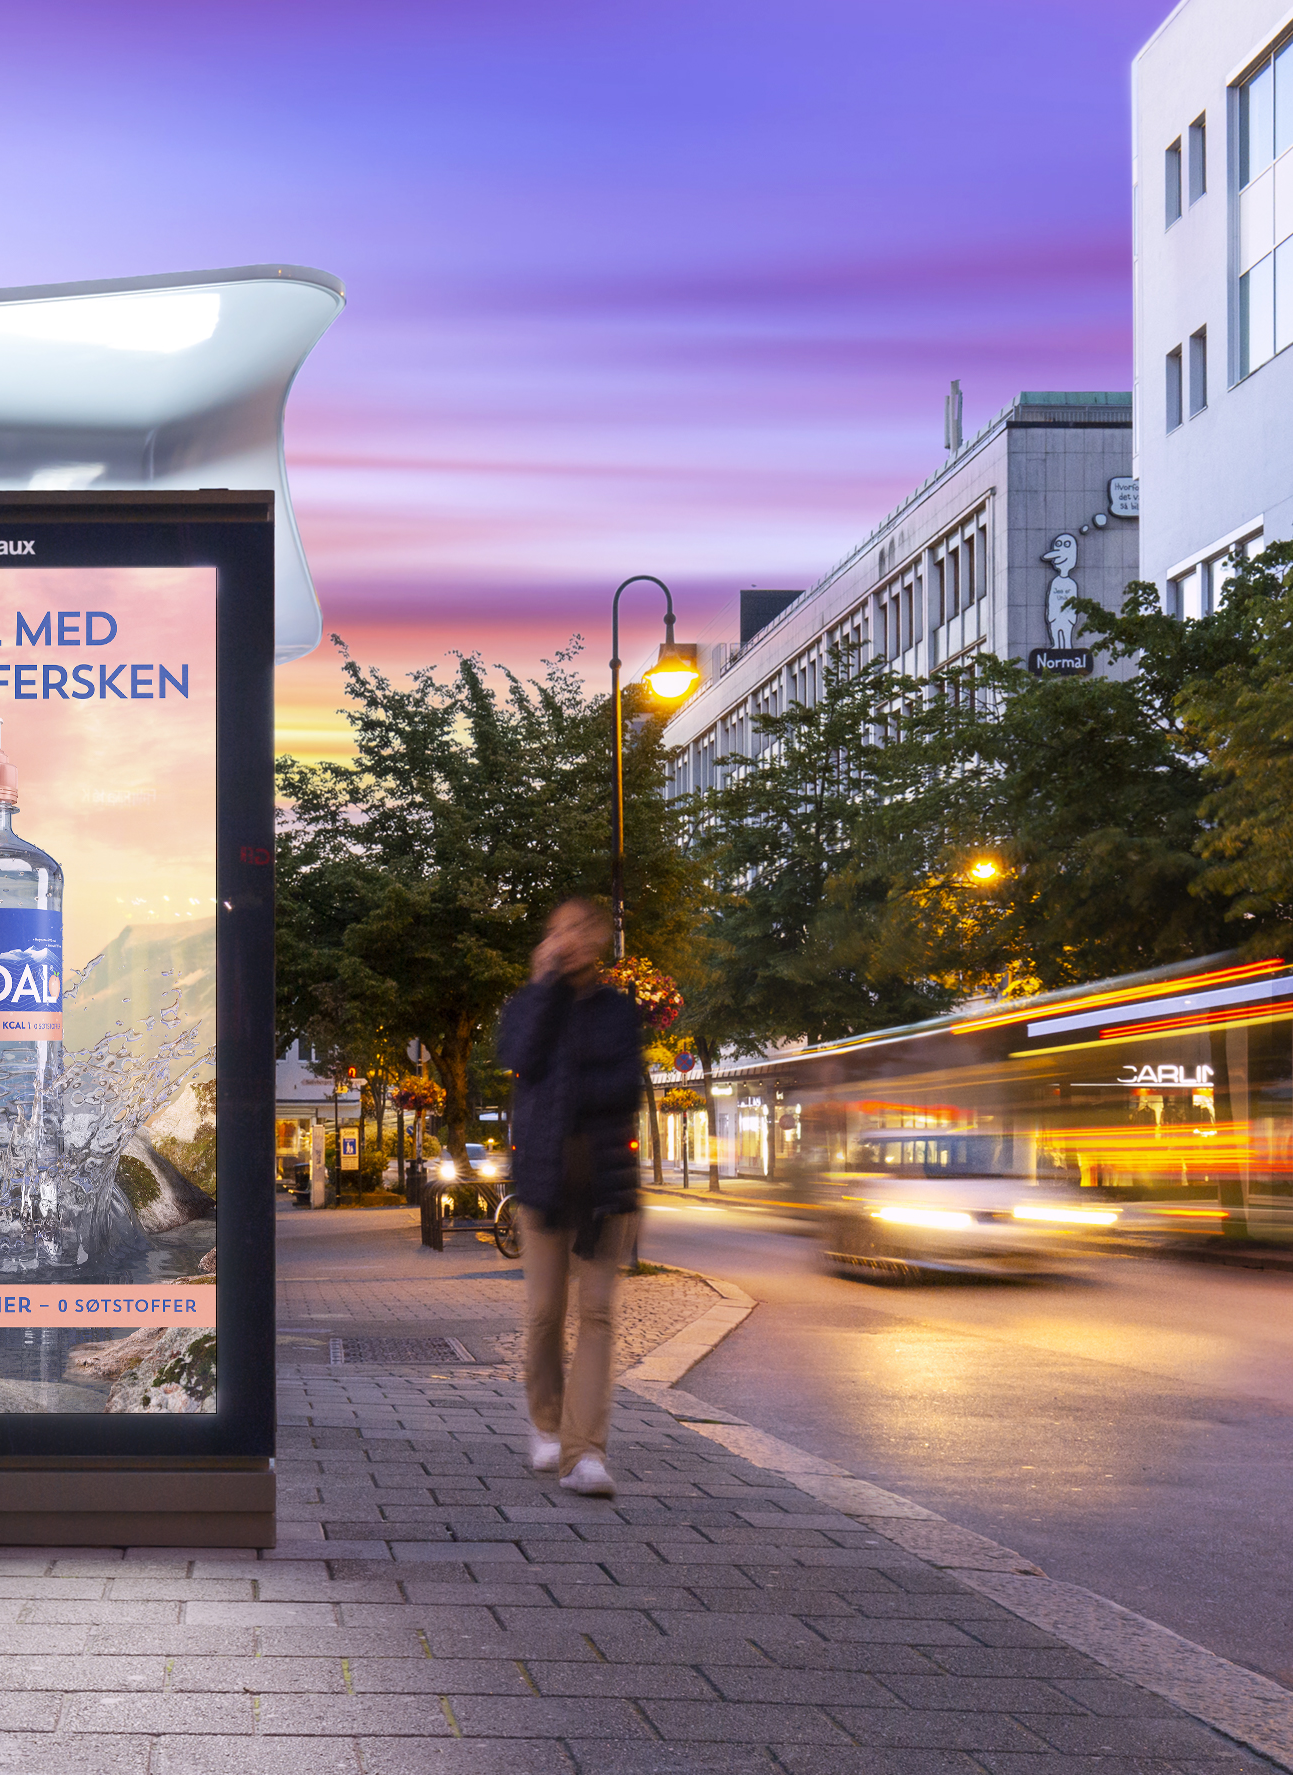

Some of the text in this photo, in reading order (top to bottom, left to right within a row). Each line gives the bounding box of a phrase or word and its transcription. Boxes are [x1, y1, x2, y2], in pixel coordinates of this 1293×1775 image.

[15, 611, 118, 647] MED
[1036, 652, 1087, 669] Normal
[2, 1021, 26, 1030] KCAL
[58, 1299, 68, 1313] 0
[75, 1299, 197, 1313] SØTSTOFFER
